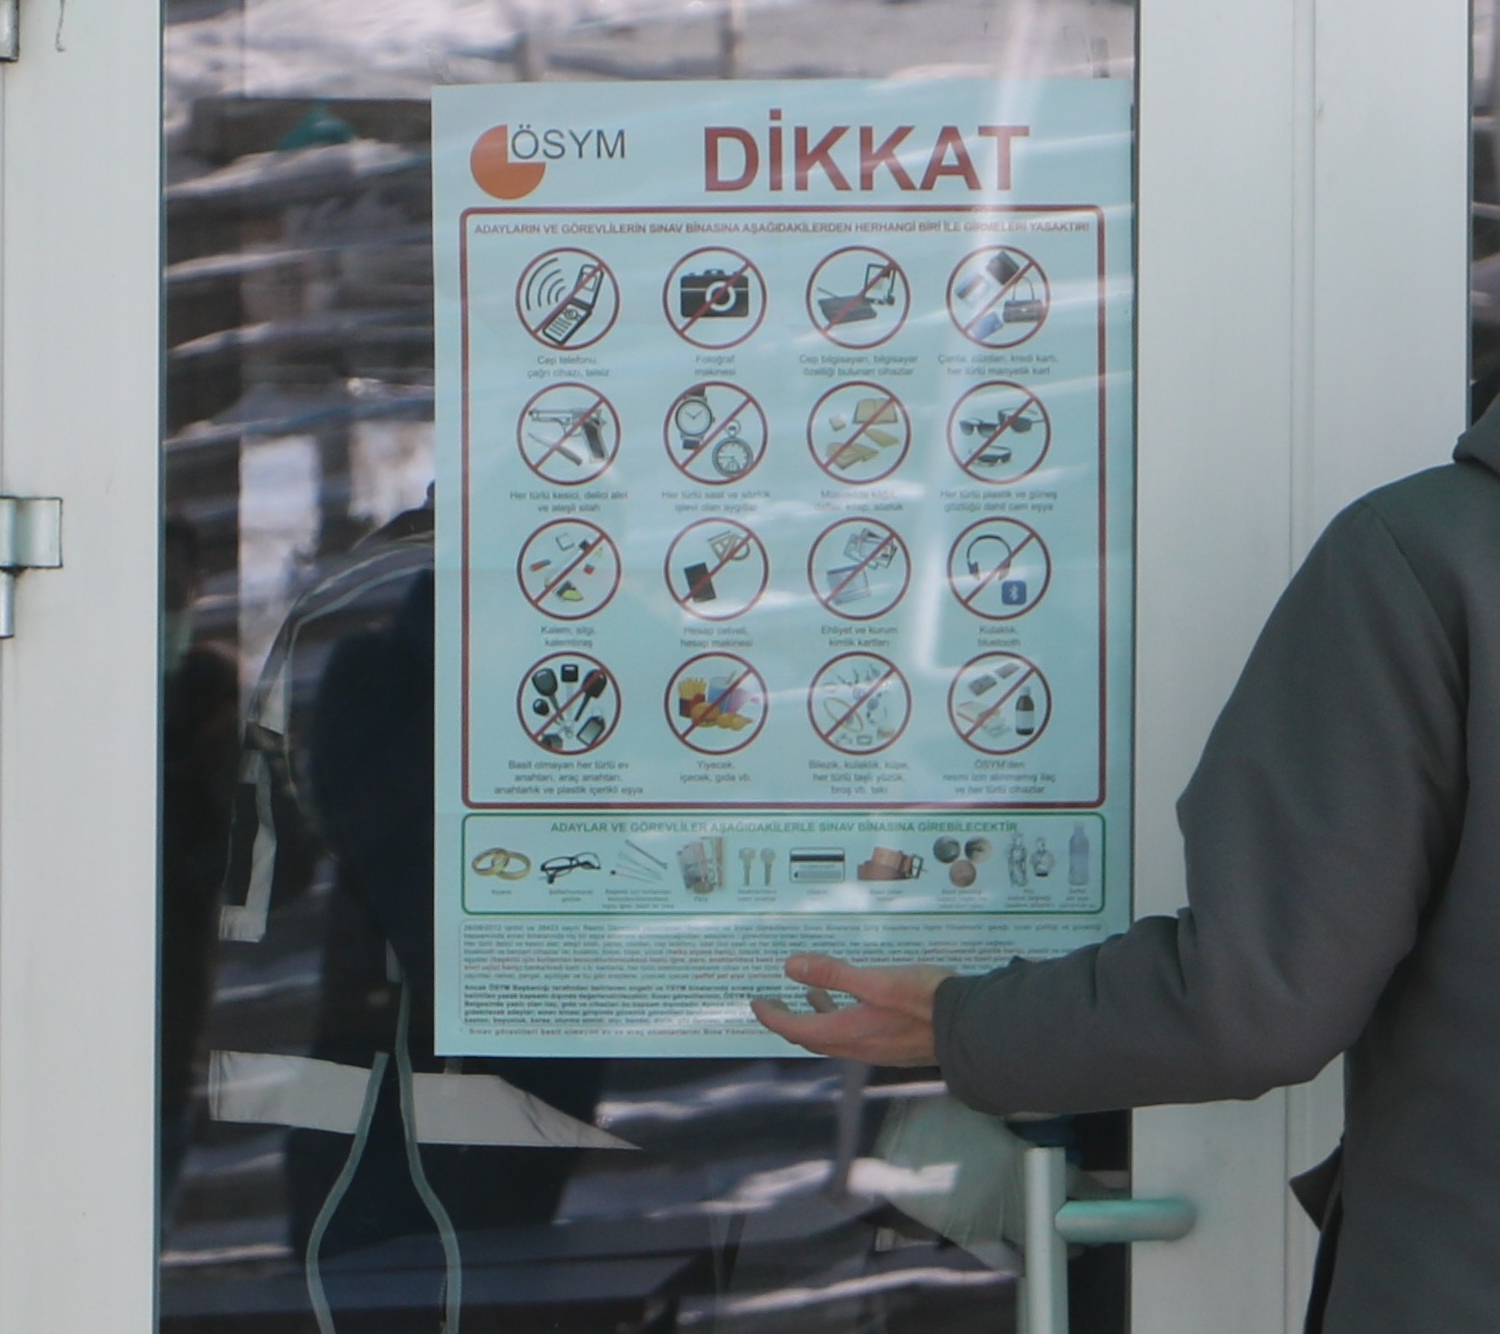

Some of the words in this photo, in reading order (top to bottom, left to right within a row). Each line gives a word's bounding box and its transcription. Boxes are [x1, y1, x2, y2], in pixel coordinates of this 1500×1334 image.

[510, 124, 626, 160] ÖSYM
[703, 108, 1030, 192] DİKKAT
[475, 223, 540, 234] ADAYLARIN
[543, 224, 558, 234] VE
[649, 223, 682, 233] SINAV
[550, 822, 607, 832] ADAYLAR
[610, 822, 628, 832] VE
